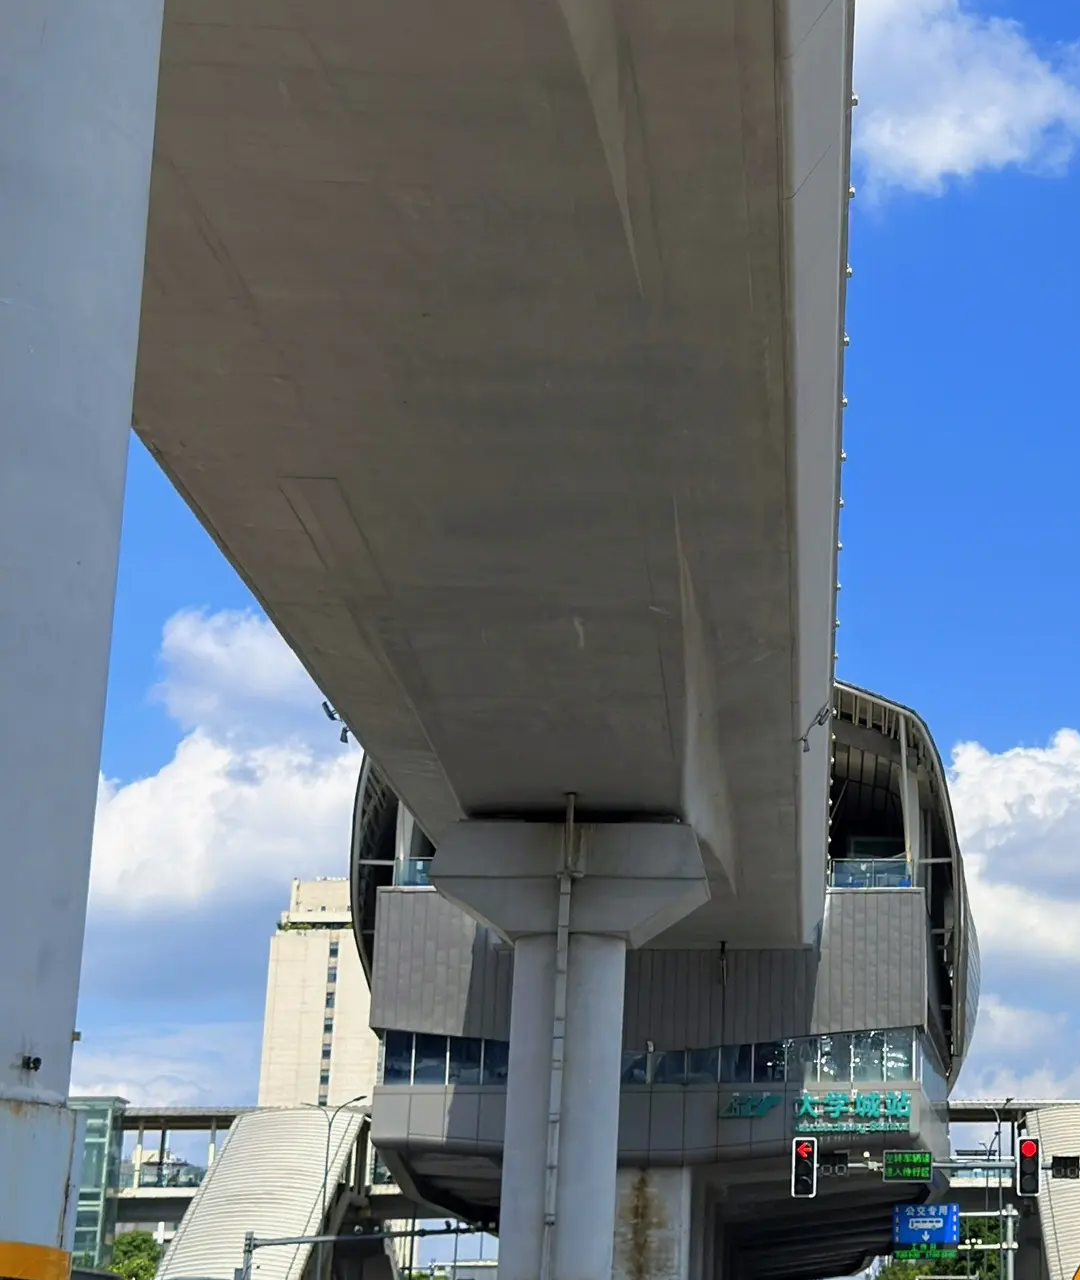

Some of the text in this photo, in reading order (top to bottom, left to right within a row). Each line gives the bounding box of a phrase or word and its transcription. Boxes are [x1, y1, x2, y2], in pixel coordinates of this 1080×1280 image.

[794, 1089, 912, 1119] 大学城站
[905, 1205, 948, 1216] 公交专用
